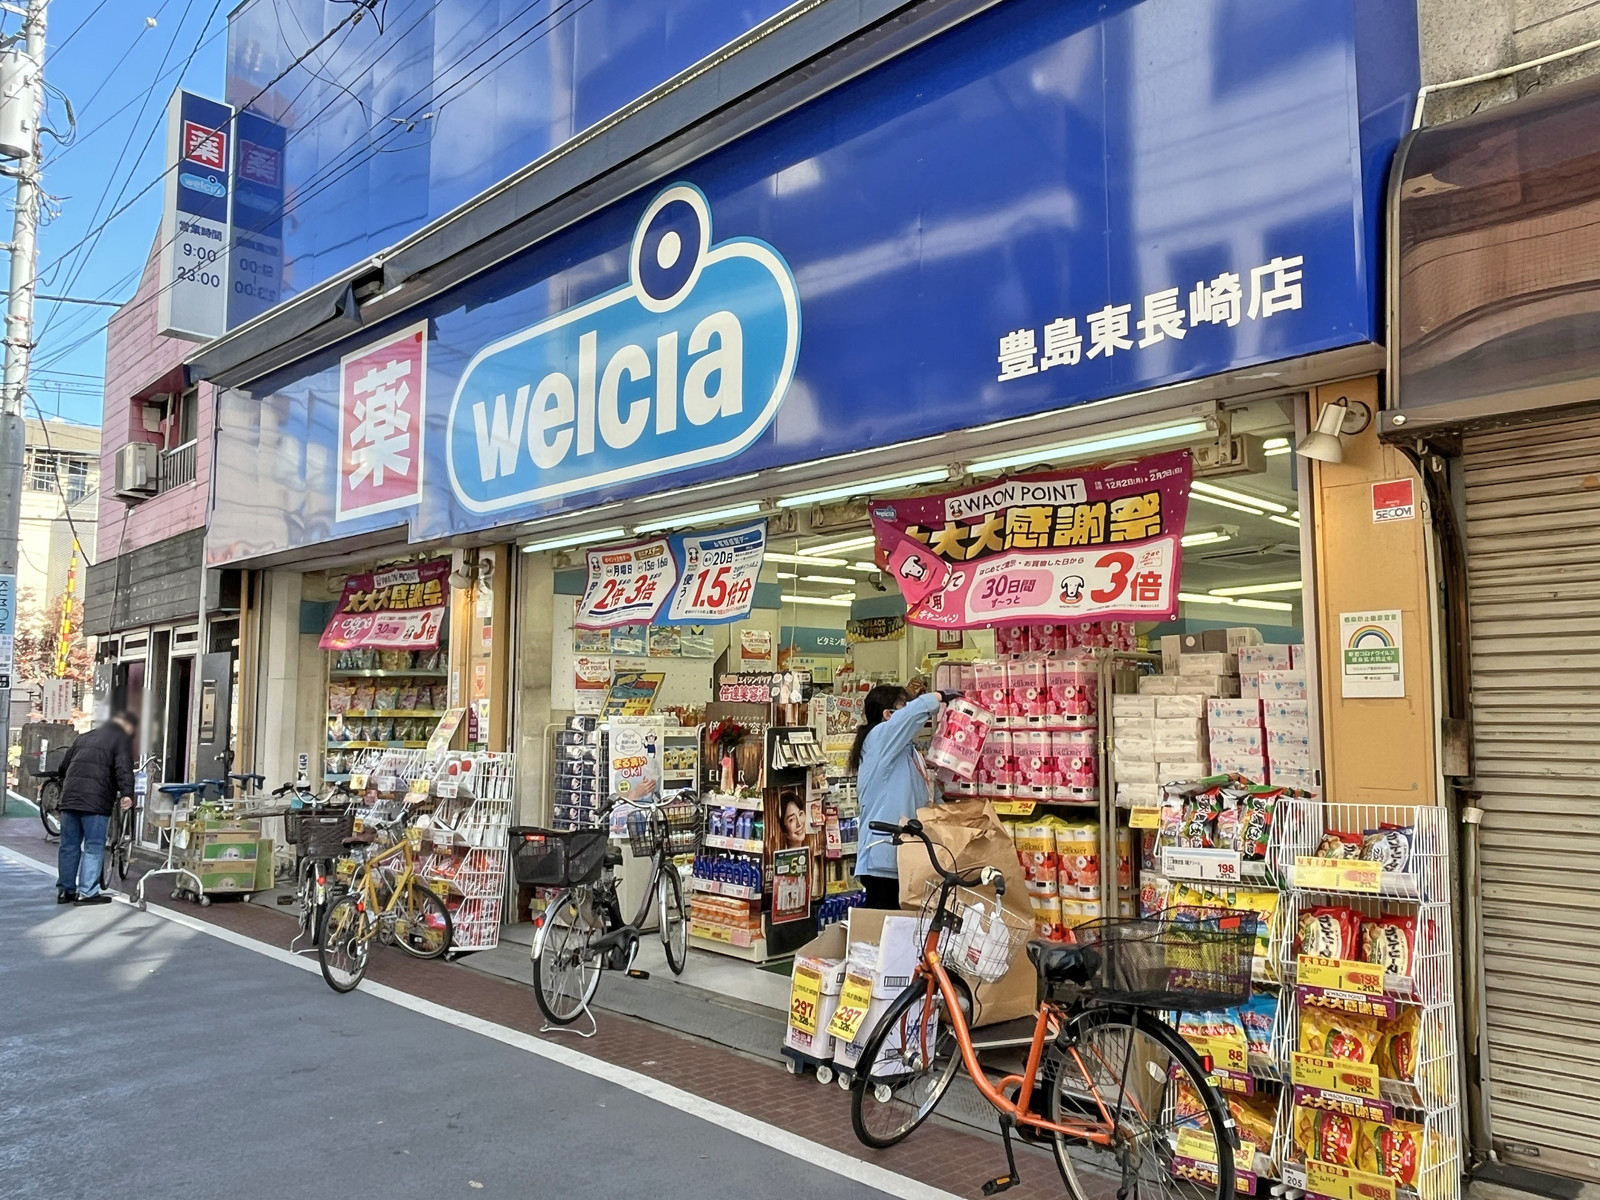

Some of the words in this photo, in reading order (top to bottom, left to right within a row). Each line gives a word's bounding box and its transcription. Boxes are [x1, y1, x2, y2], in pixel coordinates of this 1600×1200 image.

[189, 128, 219, 163] 薬
[184, 178, 221, 196] welcia
[179, 220, 223, 242] 営業時間
[183, 243, 217, 263] 9:00
[177, 266, 220, 288] 23:00
[997, 255, 1304, 382] 豊島東長崎店
[472, 310, 743, 482] welcia
[348, 359, 411, 491] 薬
[962, 486, 1015, 512] WAON
[1021, 484, 1079, 503] POINT
[1376, 507, 1412, 520] SECOM
[713, 551, 733, 566] 20日
[981, 574, 1037, 600] 30日間
[1090, 551, 1163, 604] 3倍
[594, 579, 626, 609] 2倍
[624, 574, 658, 604] 3倍
[1217, 863, 1235, 874] 198
[1360, 974, 1380, 986] 198
[792, 998, 814, 1018] 297
[837, 1005, 862, 1025] 297
[1228, 1049, 1243, 1061] 88
[1353, 1076, 1372, 1088] 198
[1287, 1175, 1303, 1188] 205
